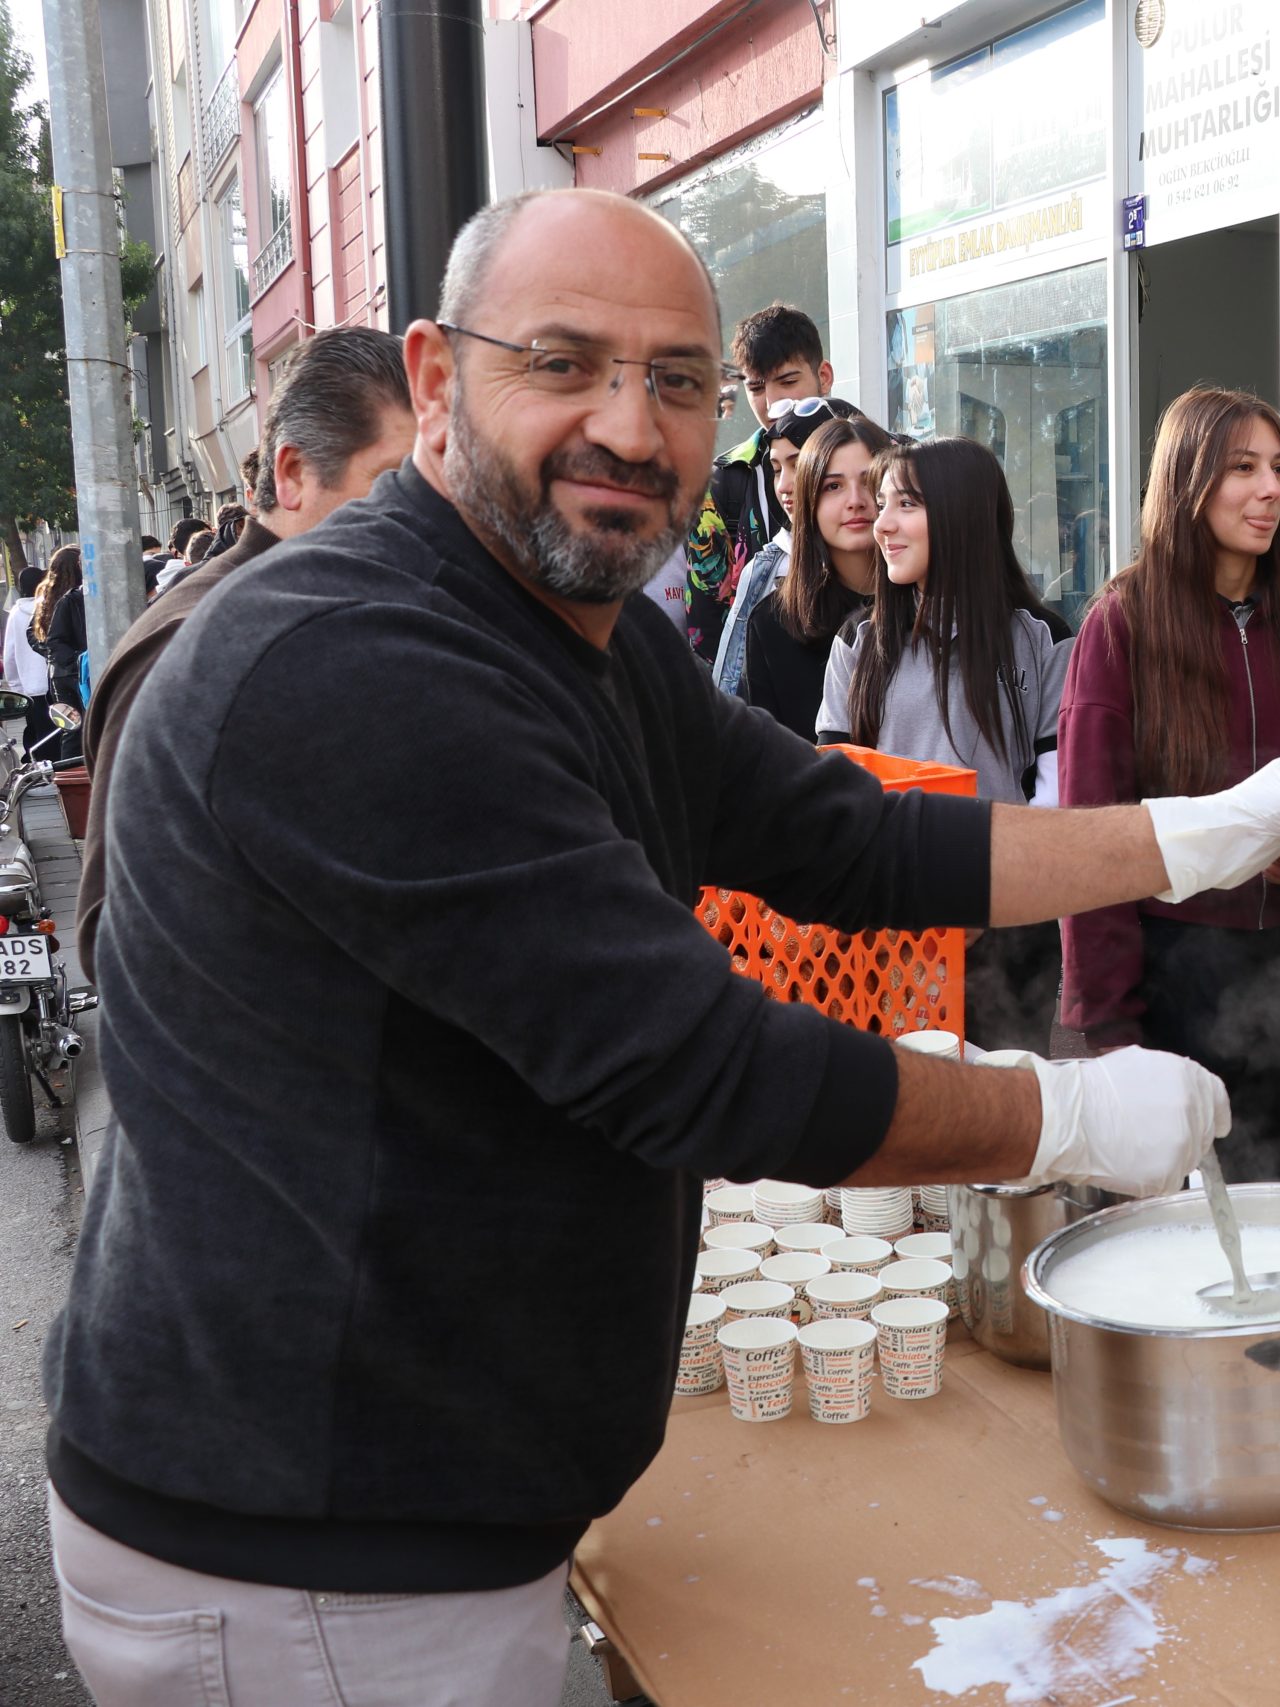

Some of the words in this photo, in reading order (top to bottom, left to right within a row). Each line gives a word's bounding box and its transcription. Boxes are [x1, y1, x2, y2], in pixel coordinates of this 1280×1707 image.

[1170, 3, 1243, 59] PULUR
[1146, 29, 1271, 114] MAHALLESİ
[1138, 80, 1279, 161] MUHTARLIĞI
[958, 224, 994, 263] EMLAK
[825, 1302, 873, 1313] Chocolate
[883, 1325, 932, 1334] Chocolate
[746, 1345, 787, 1361] Coffee
[805, 1347, 854, 1357] Chocolate
[906, 1344, 931, 1352] Coffee
[748, 1372, 783, 1381] Espresso
[827, 1368, 853, 1376] Coffee
[900, 1387, 927, 1396] Coffee
[767, 1397, 787, 1407] Tea
[822, 1411, 850, 1421] Coffee
